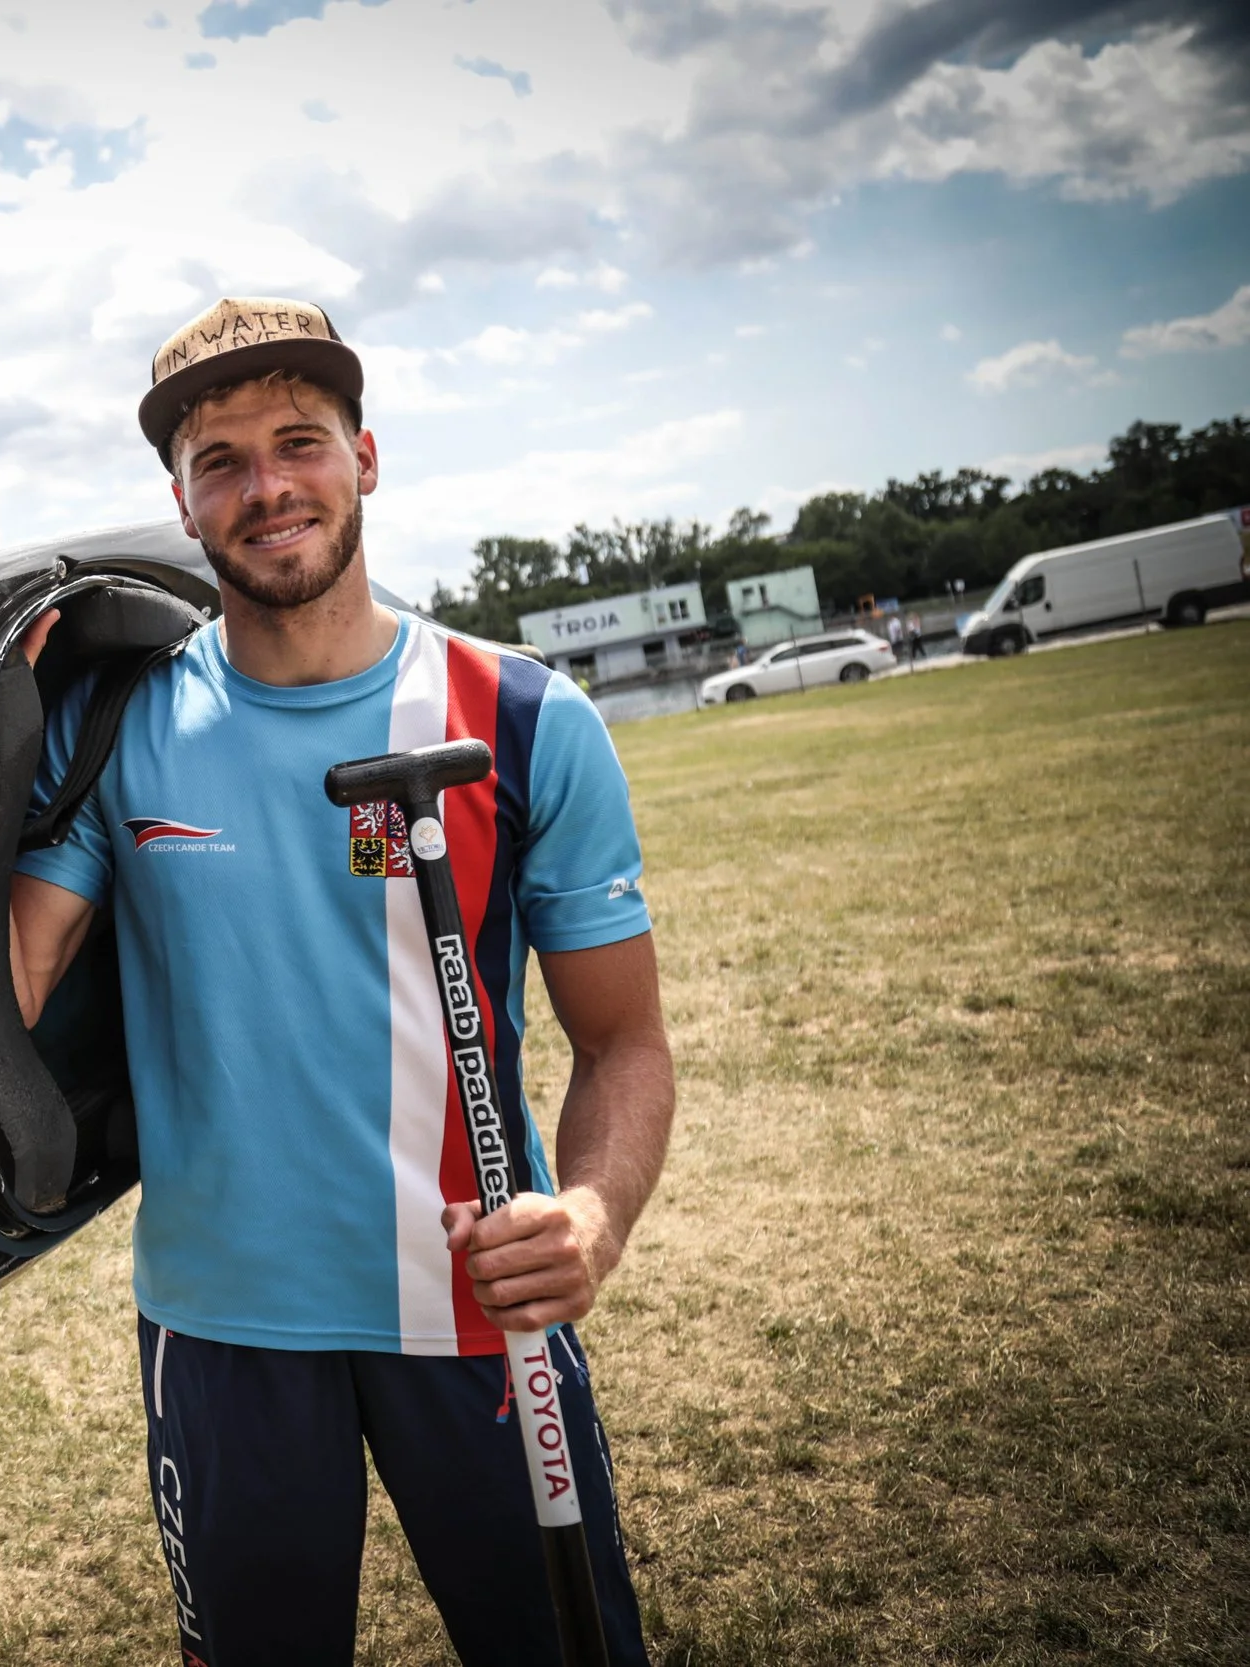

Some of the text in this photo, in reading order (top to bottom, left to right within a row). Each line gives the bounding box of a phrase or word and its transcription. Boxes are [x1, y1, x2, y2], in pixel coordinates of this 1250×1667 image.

[166, 341, 188, 374] IN
[199, 311, 313, 345] WATER
[551, 611, 621, 638] TROJA
[148, 843, 236, 853] CZECH CANOE TEAM
[435, 934, 482, 1040] raab
[523, 1345, 572, 1502] TOYOTA
[159, 1455, 202, 1641] CZECH
